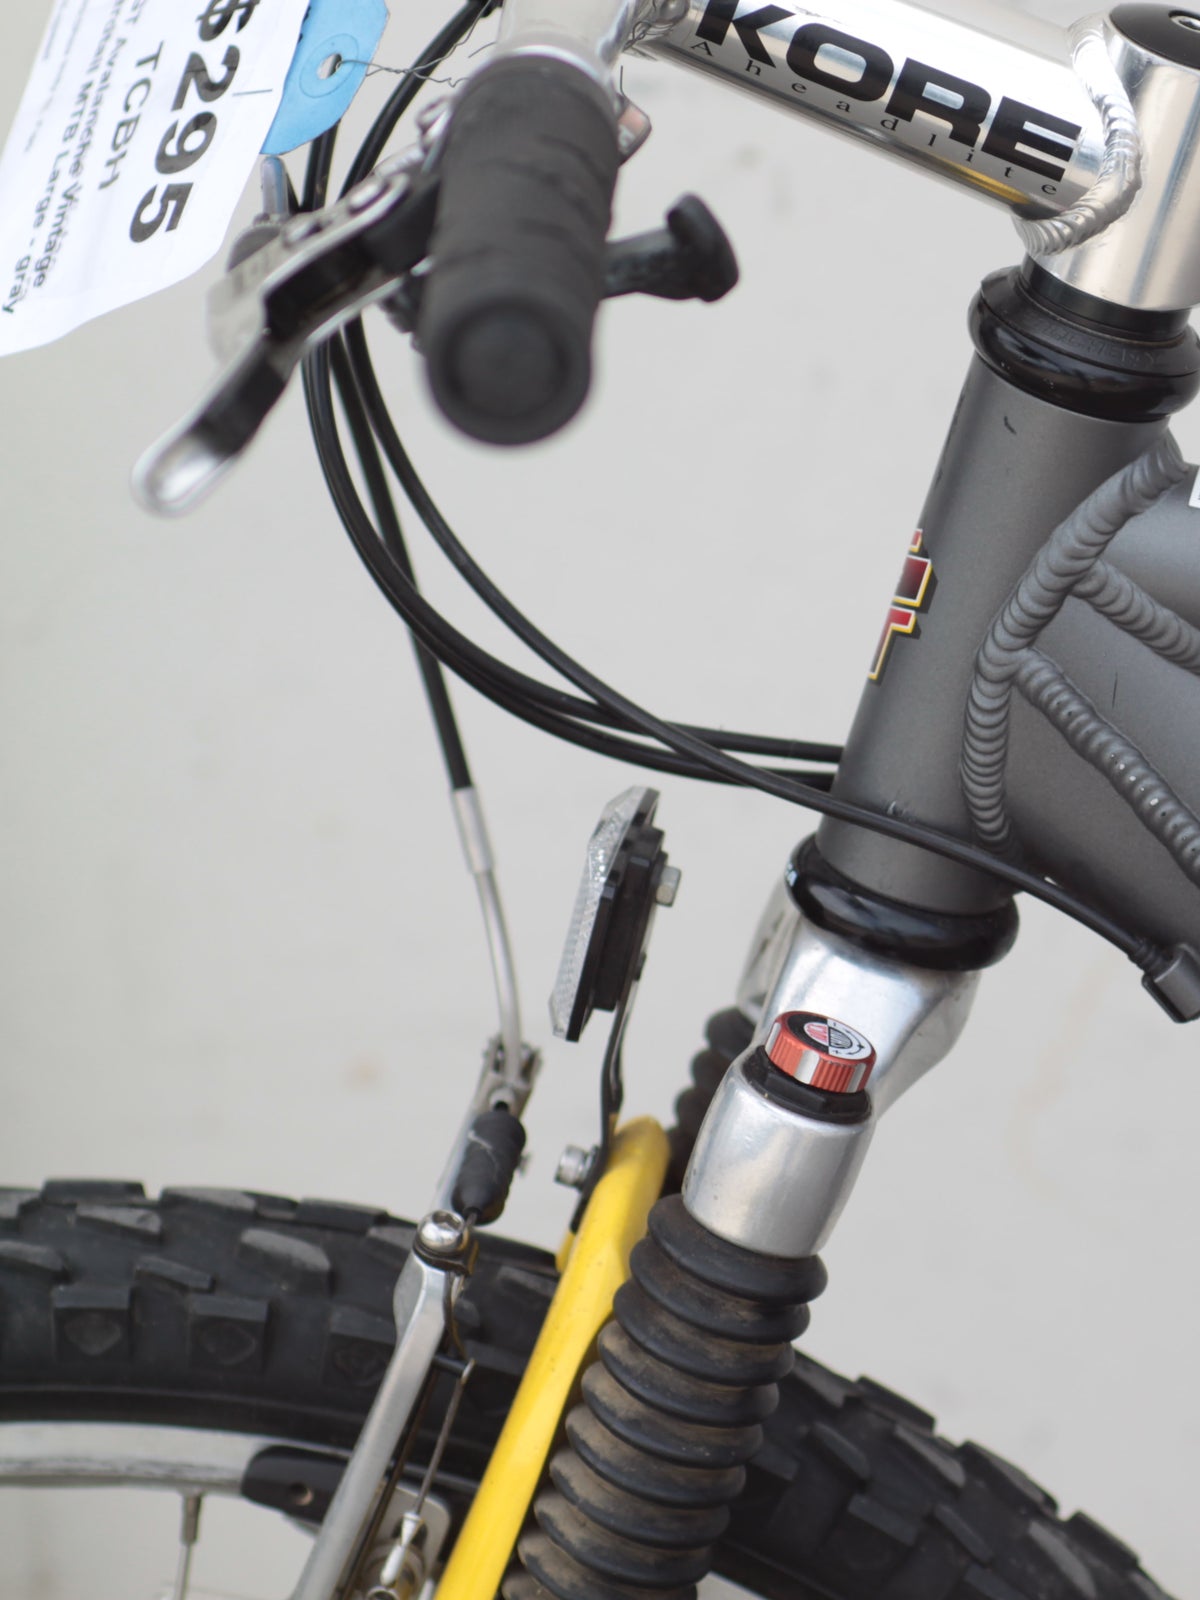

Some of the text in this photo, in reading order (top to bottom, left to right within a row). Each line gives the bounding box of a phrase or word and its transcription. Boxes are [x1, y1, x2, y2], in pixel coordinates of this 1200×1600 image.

[62, 80, 94, 143] MTB
[98, 40, 164, 190] TCBH
[696, 0, 1082, 182] KORE
[33, 150, 70, 229] Large
[33, 181, 83, 288] Vintage
[2, 255, 32, 314] gray
